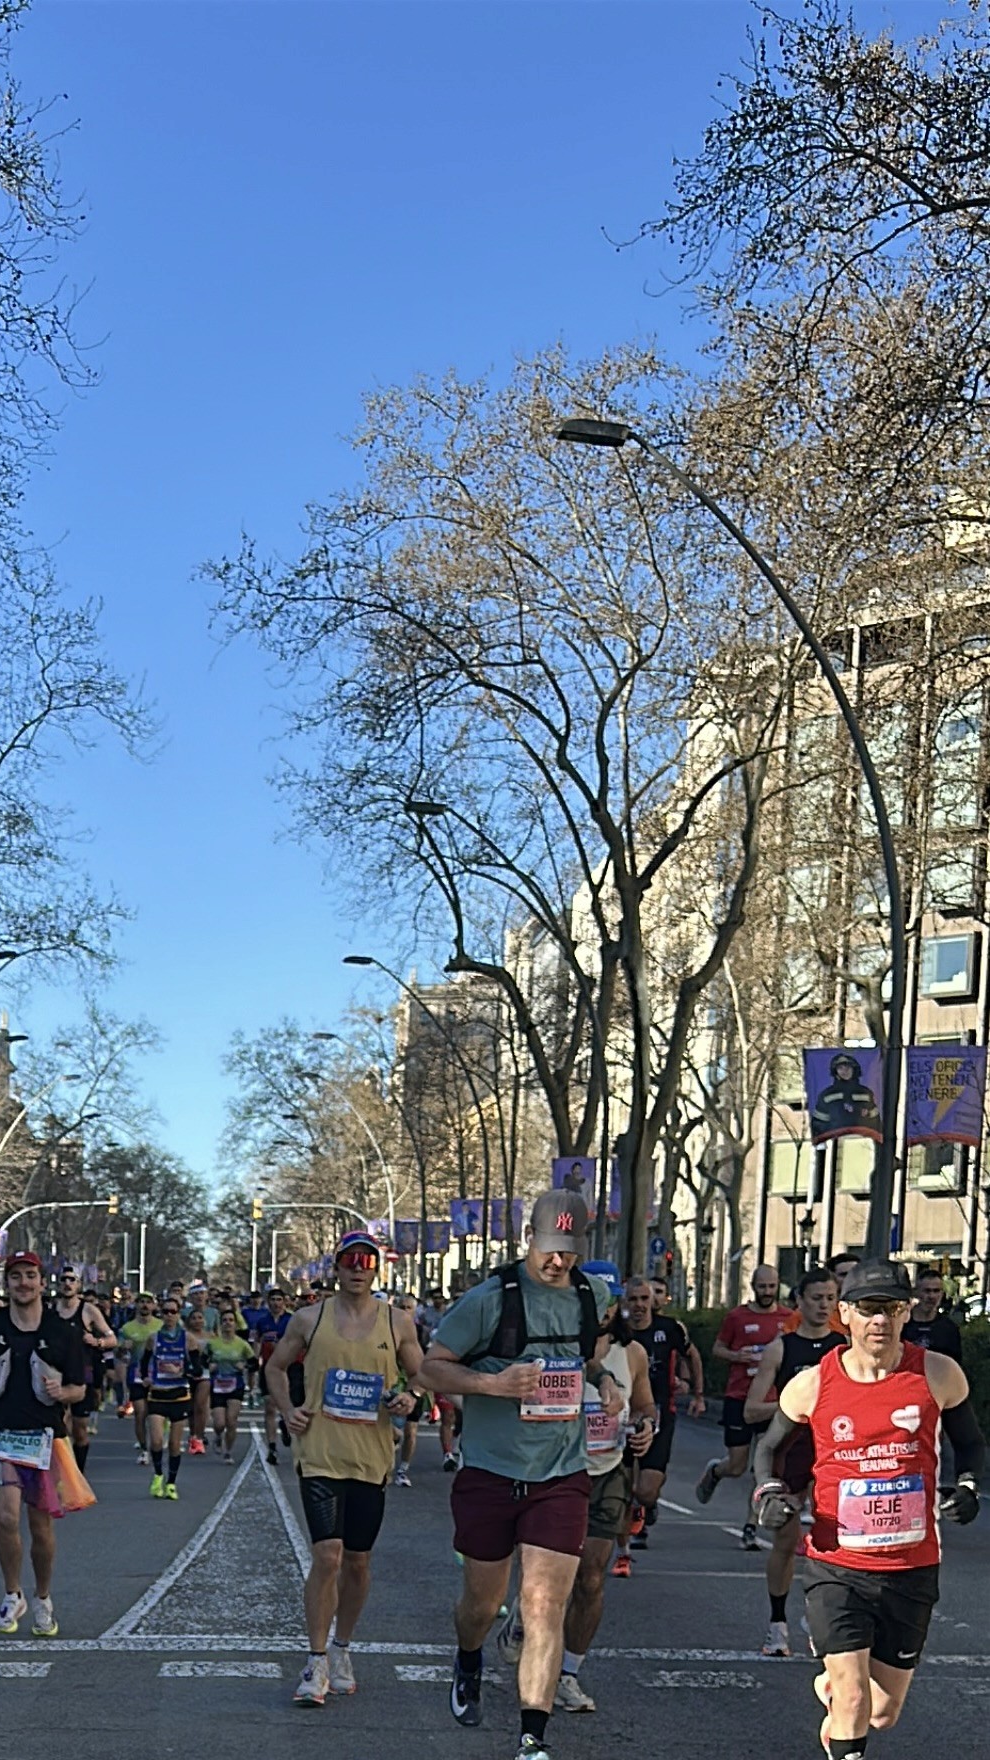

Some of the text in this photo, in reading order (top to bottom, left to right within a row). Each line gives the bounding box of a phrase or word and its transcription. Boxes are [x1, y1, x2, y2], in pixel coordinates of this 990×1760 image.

[548, 1360, 576, 1368] ZURICH
[334, 1383, 374, 1398] LENAIC
[586, 1415, 609, 1428] NCE
[870, 1481, 910, 1493] ZURICH
[864, 1495, 902, 1515] JÉJÉ
